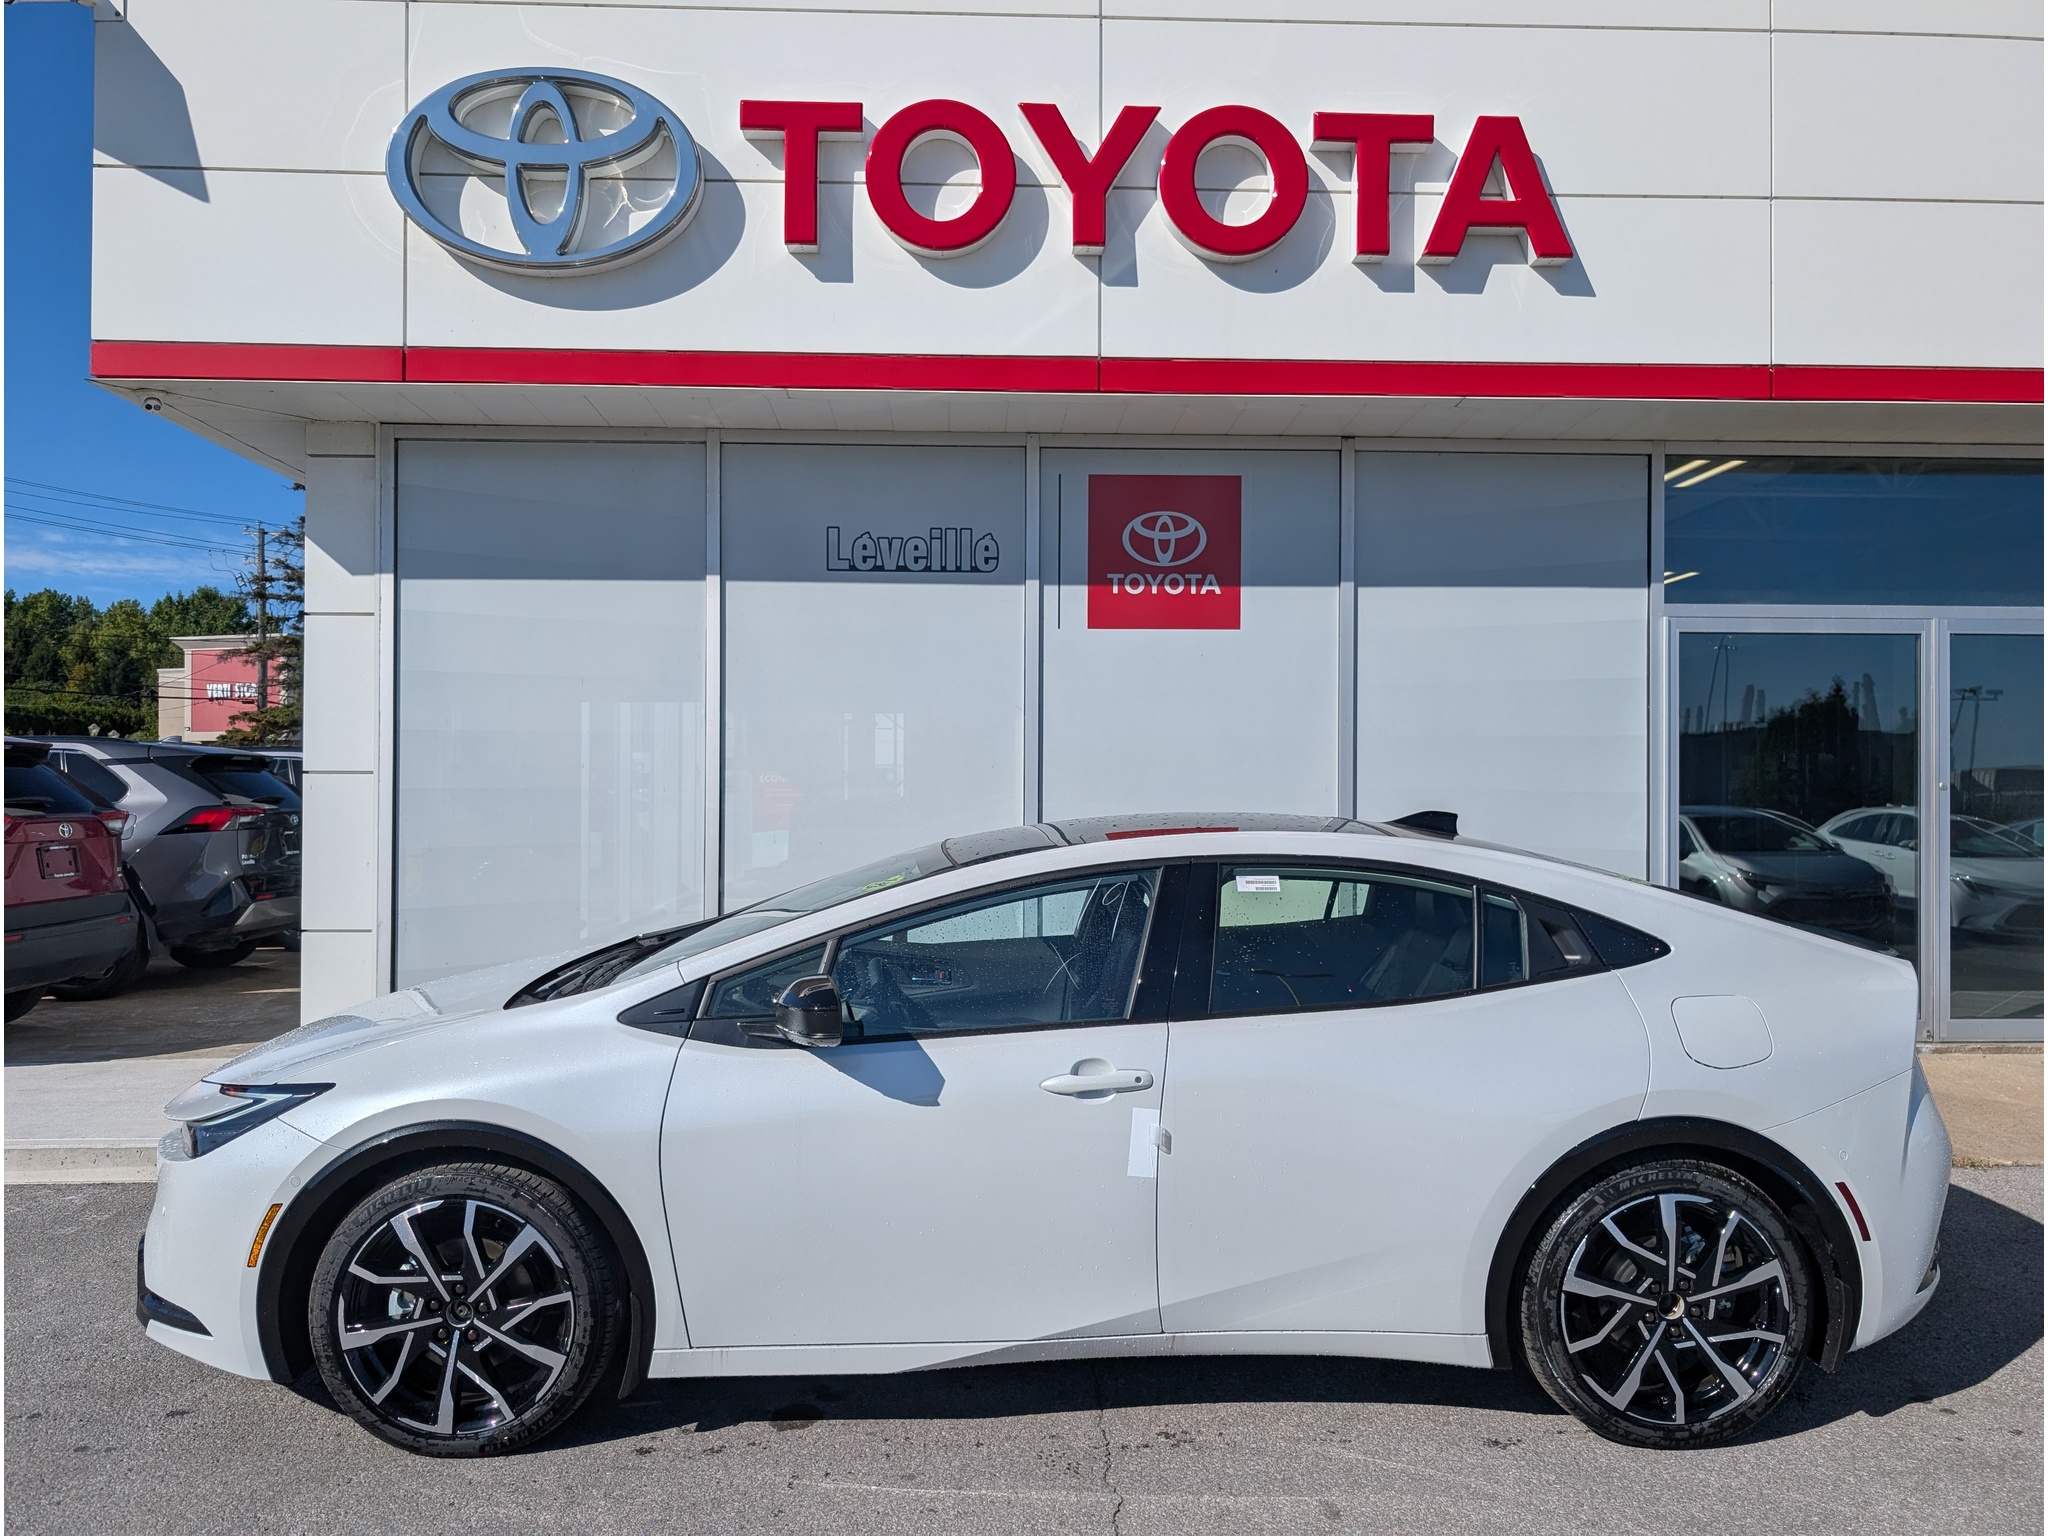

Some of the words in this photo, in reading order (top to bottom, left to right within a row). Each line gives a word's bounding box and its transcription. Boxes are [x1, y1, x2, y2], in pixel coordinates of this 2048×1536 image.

[739, 98, 1575, 264] TOYOTA
[826, 526, 999, 573] Léveillé
[1106, 573, 1222, 595] TOYOTA
[206, 683, 231, 698] VERTI
[1618, 1171, 1694, 1191] MICHELIN
[358, 1178, 430, 1224] MICHELIN
